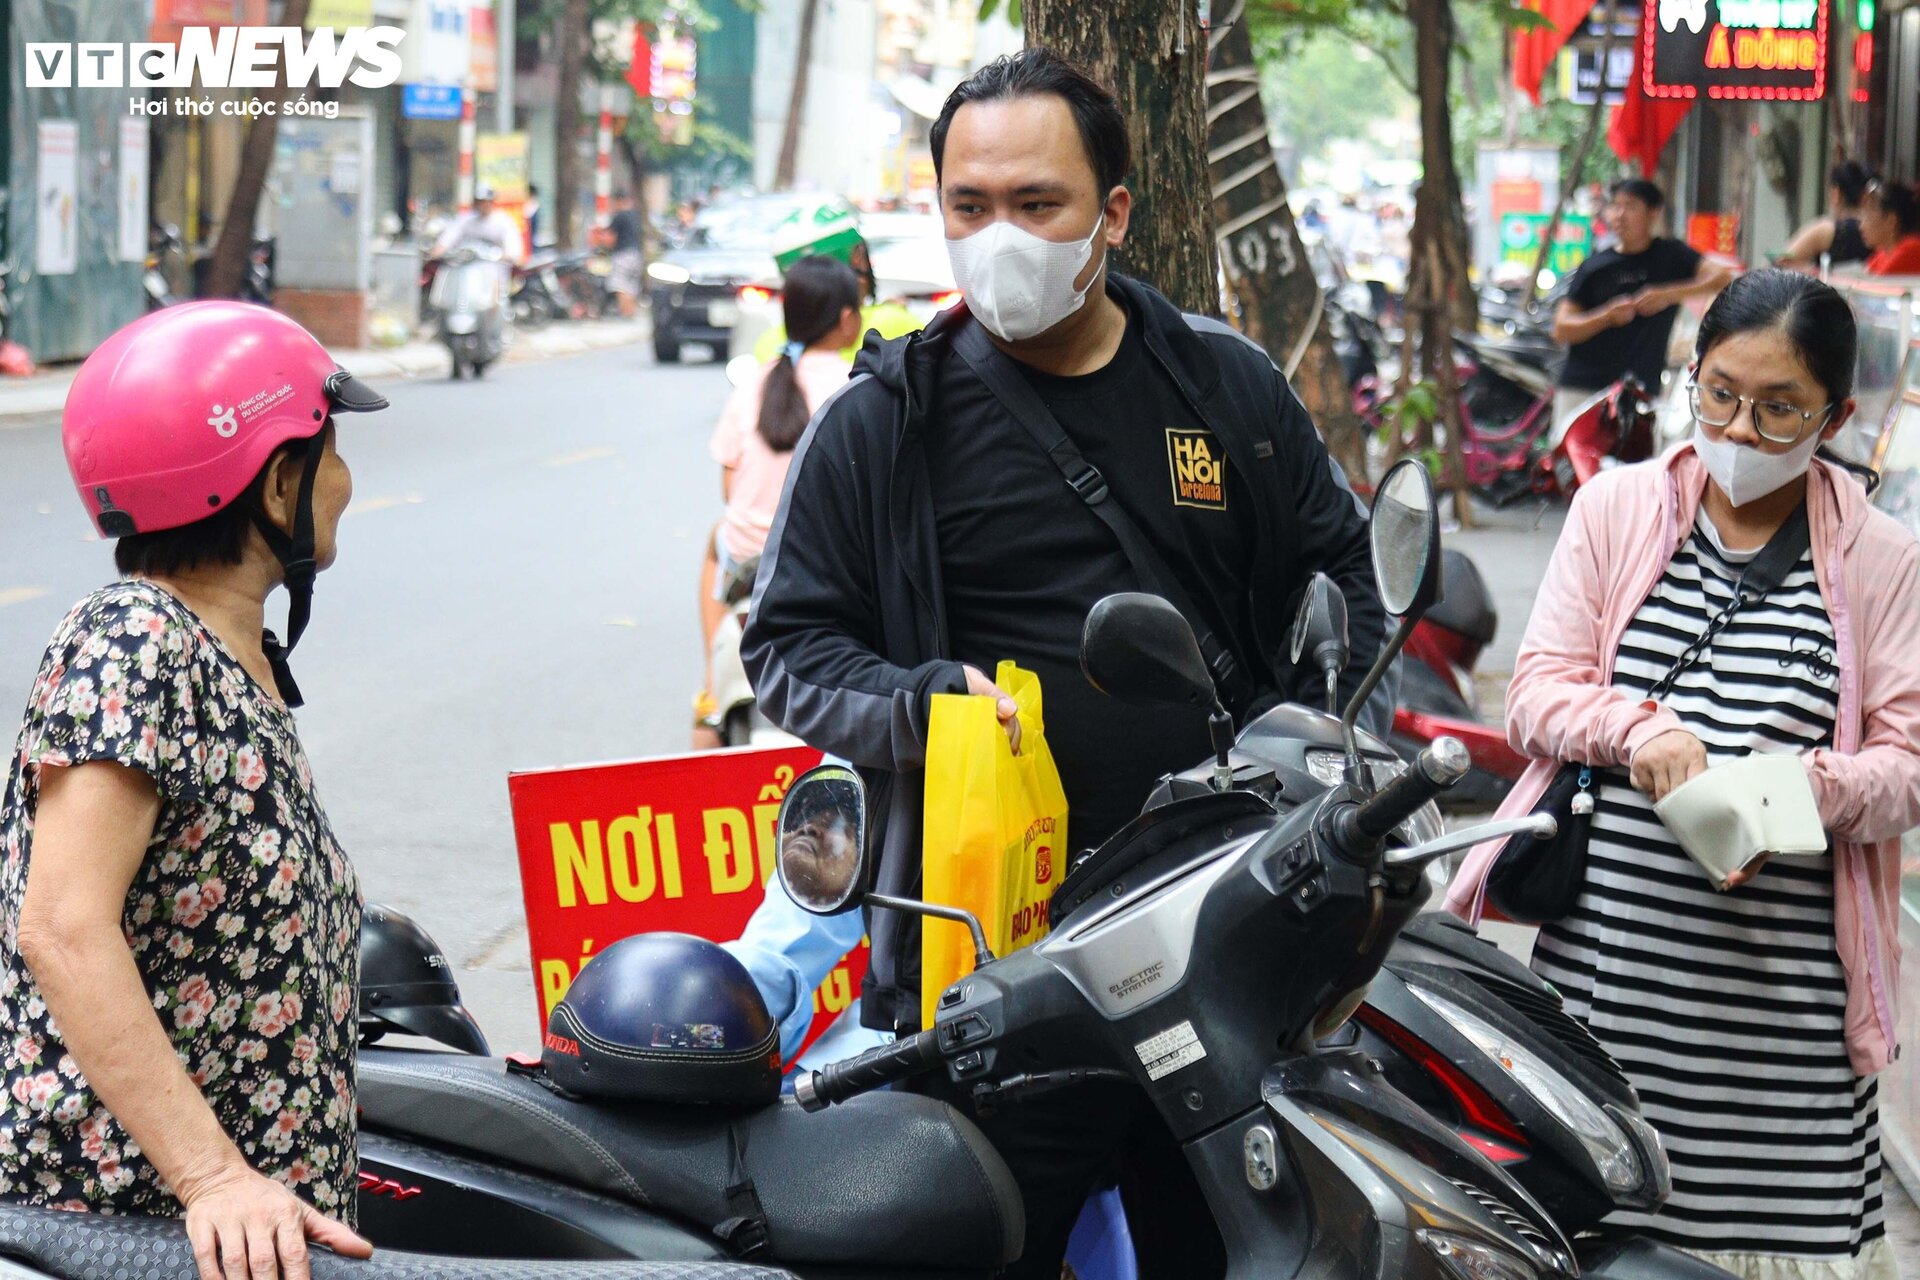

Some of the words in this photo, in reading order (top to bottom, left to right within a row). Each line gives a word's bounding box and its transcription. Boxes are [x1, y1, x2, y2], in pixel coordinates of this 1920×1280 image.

[1705, 23, 1731, 69] Á
[1733, 28, 1816, 70] ĐÔNG
[1173, 436, 1212, 461] HA
[1176, 459, 1221, 484] NOI
[549, 806, 683, 908] NƠI
[1108, 961, 1164, 995] ELECTRIC
[1116, 971, 1162, 999] STARTER
